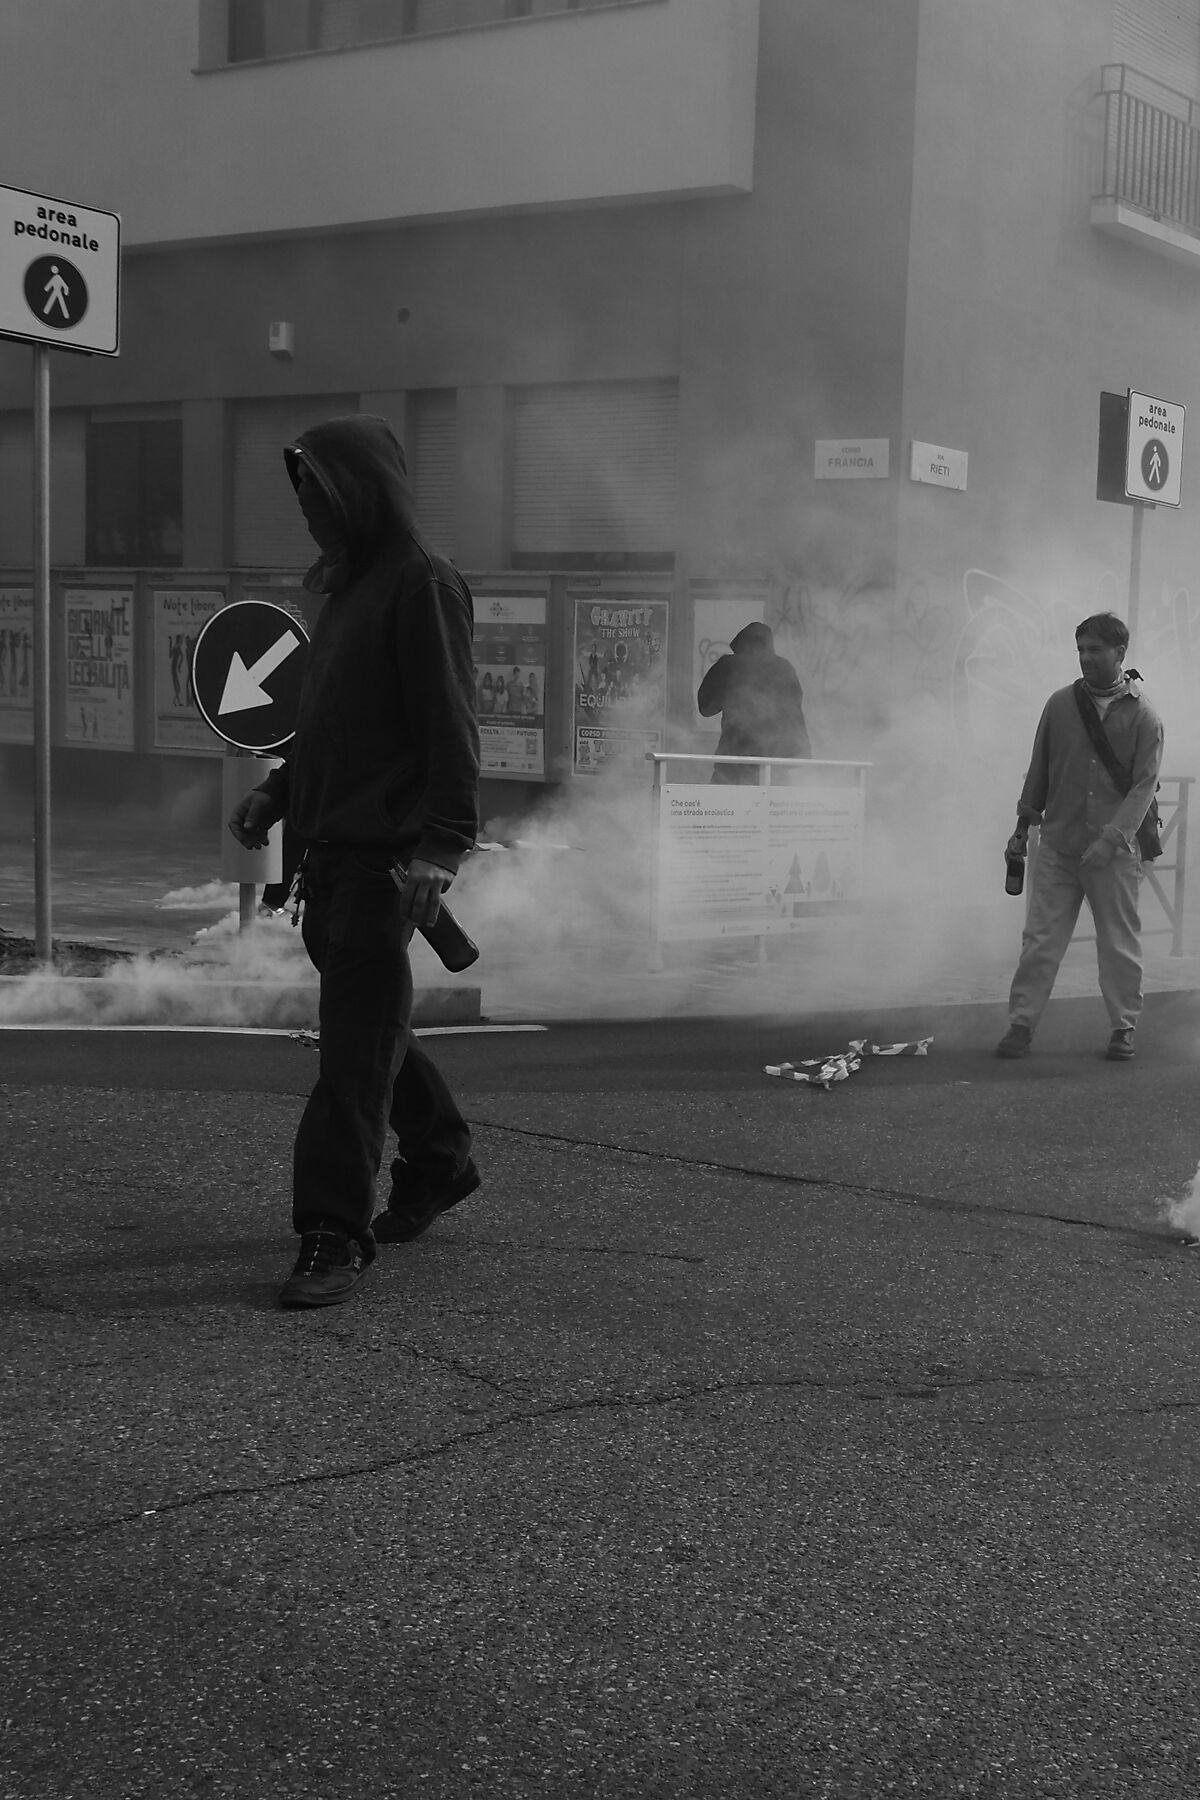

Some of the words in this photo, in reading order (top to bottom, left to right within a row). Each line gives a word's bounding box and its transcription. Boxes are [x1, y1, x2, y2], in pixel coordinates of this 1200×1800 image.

[37, 206, 77, 227] area
[14, 220, 99, 251] pedonale
[1149, 404, 1167, 417] area
[1138, 415, 1176, 434] pedonale
[827, 457, 875, 468] FRANCIA
[937, 454, 946, 462] VIA
[930, 463, 951, 478] RIETI
[591, 606, 654, 627] GRAVITY
[601, 628, 617, 638] THE
[618, 628, 640, 638] SHOW
